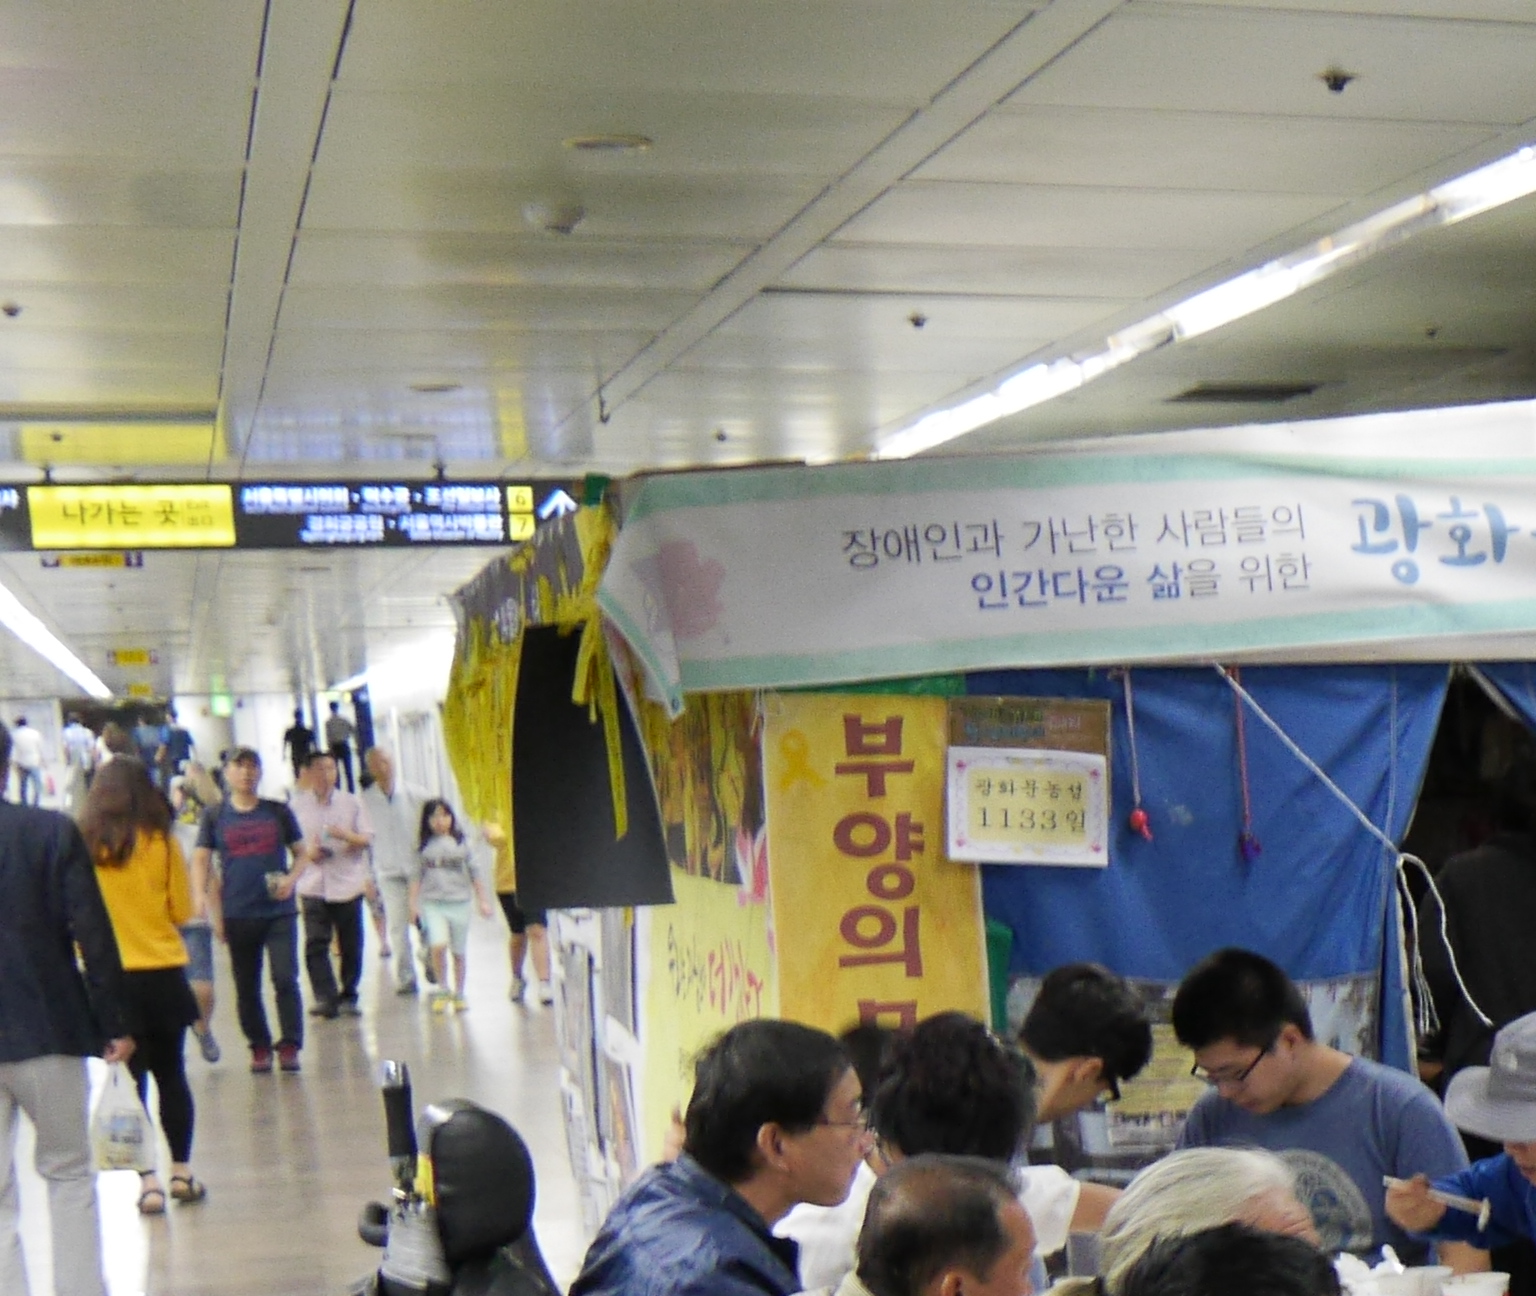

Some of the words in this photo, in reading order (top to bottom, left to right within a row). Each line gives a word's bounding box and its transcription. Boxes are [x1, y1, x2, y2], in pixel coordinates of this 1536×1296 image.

[62, 501, 142, 526] 나가는
[154, 501, 180, 526] 곳
[518, 518, 528, 532] 7
[842, 518, 1005, 571] 장애인과
[1021, 511, 1138, 557] 가난한
[1155, 501, 1308, 550] 사람들의
[970, 561, 1131, 611] 인간다운
[1146, 558, 1222, 601] 삶을
[1238, 552, 1312, 595] 위한
